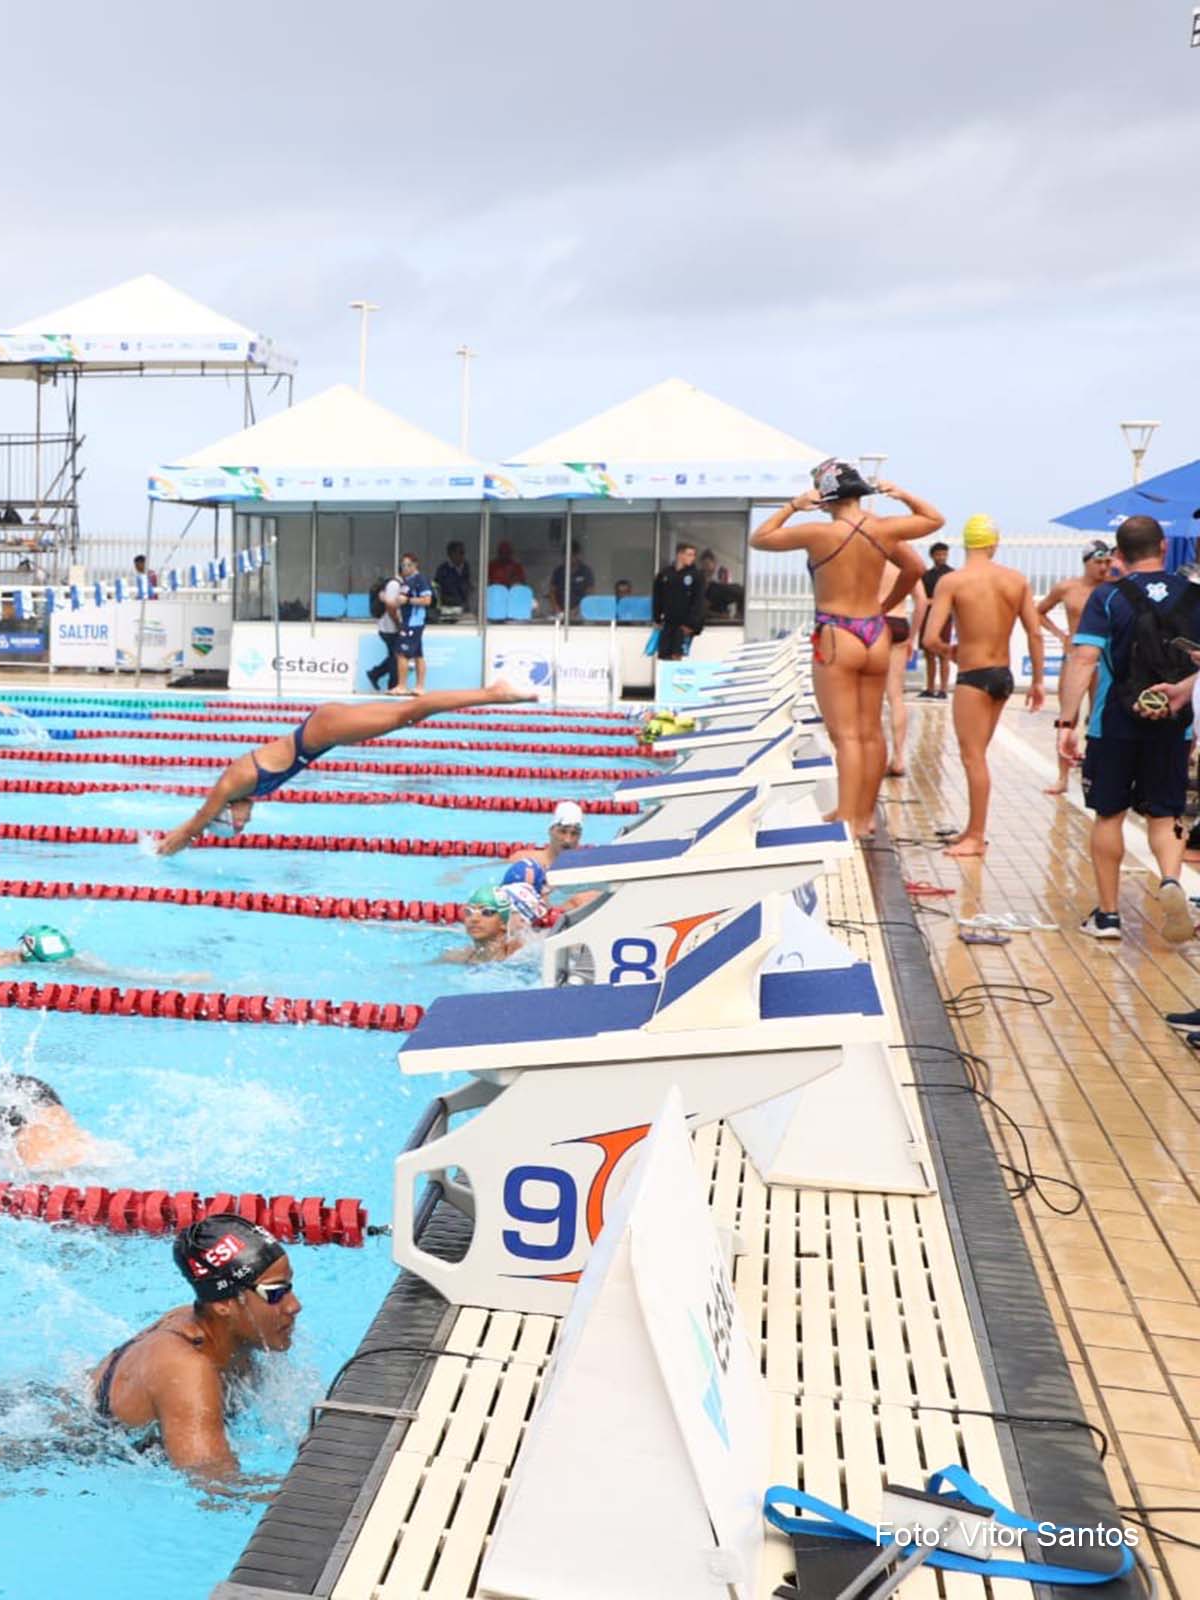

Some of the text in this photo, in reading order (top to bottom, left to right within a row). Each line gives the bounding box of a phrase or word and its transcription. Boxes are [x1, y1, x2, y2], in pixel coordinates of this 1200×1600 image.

[59, 624, 109, 639] SALTUR
[610, 937, 657, 984] 8
[502, 1165, 578, 1261] 9
